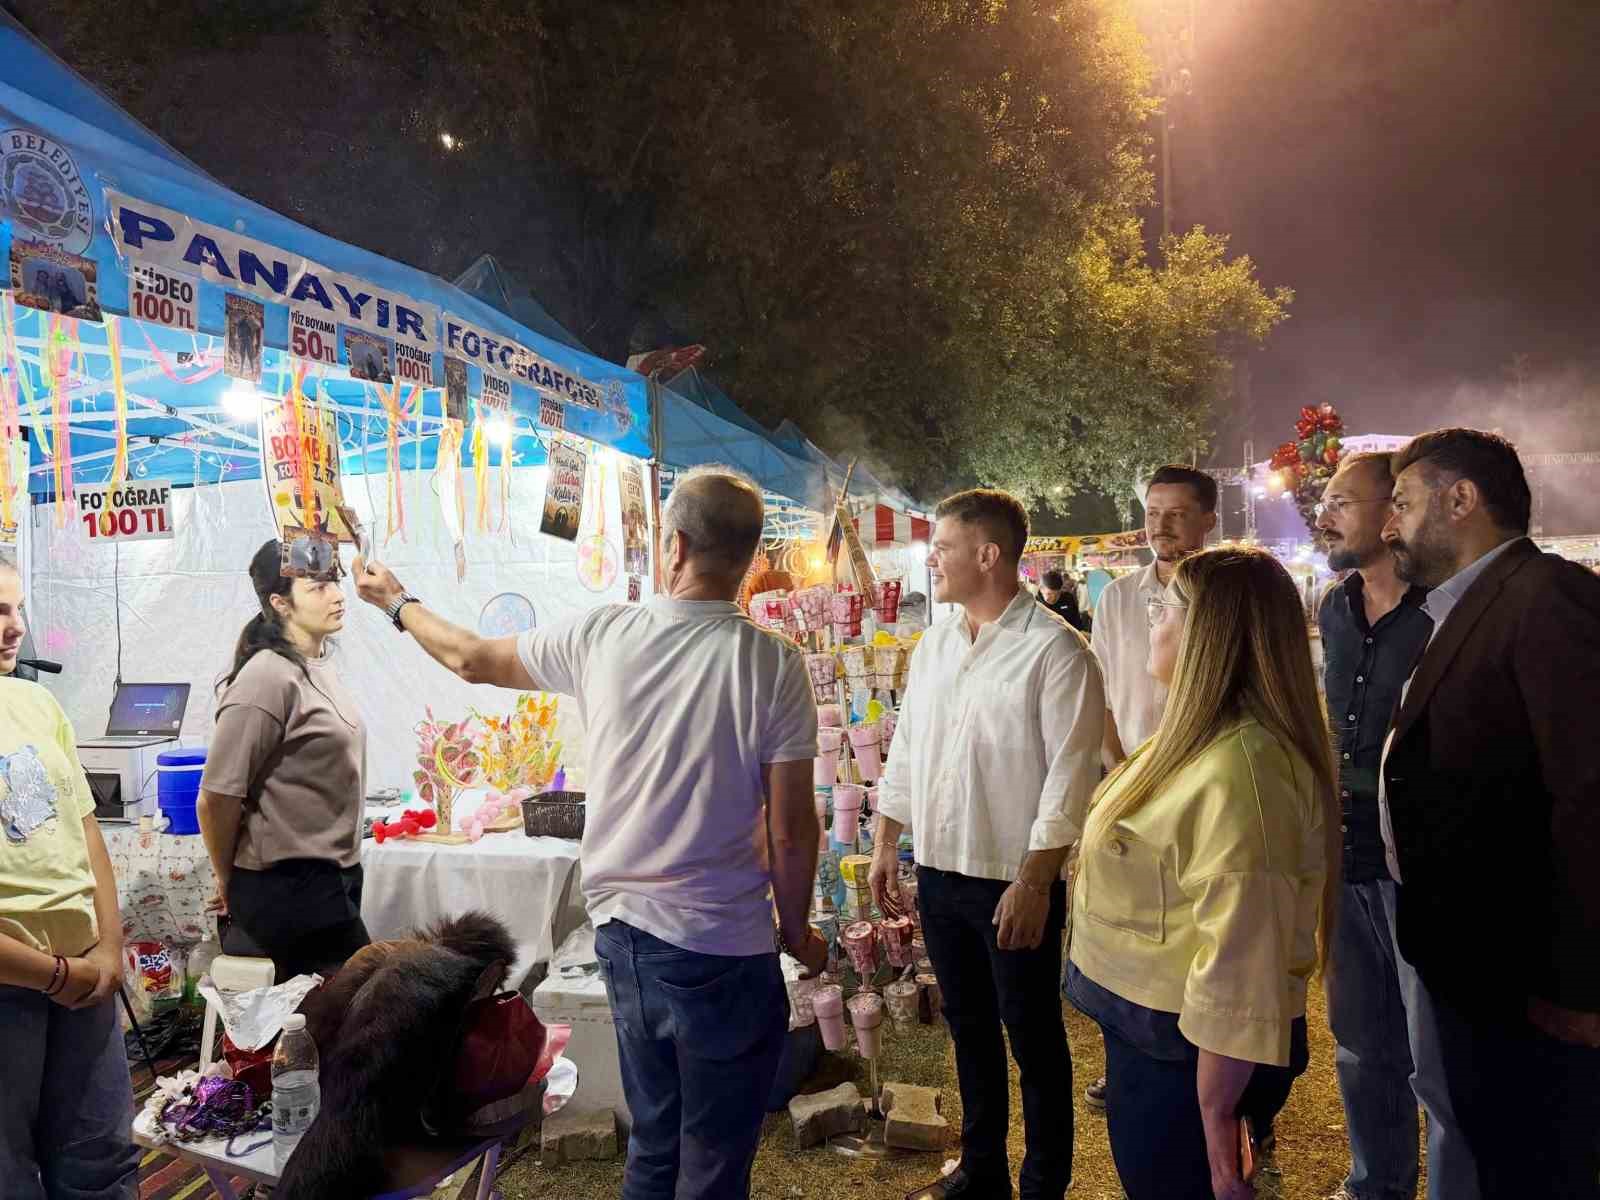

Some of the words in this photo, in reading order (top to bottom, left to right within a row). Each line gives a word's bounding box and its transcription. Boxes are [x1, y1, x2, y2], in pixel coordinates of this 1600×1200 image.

[119, 206, 427, 341] PANAYIR
[134, 266, 193, 304] VİDEO
[132, 292, 174, 324] 100
[176, 306, 194, 329] TL
[291, 311, 304, 325] YÜZ
[305, 317, 336, 334] BOYAMA
[291, 326, 323, 360] 50
[324, 345, 336, 363] TL
[397, 357, 420, 380] 100
[81, 487, 169, 511] FOTOĞRAF
[82, 512, 138, 537] 100
[141, 508, 171, 534] TL
